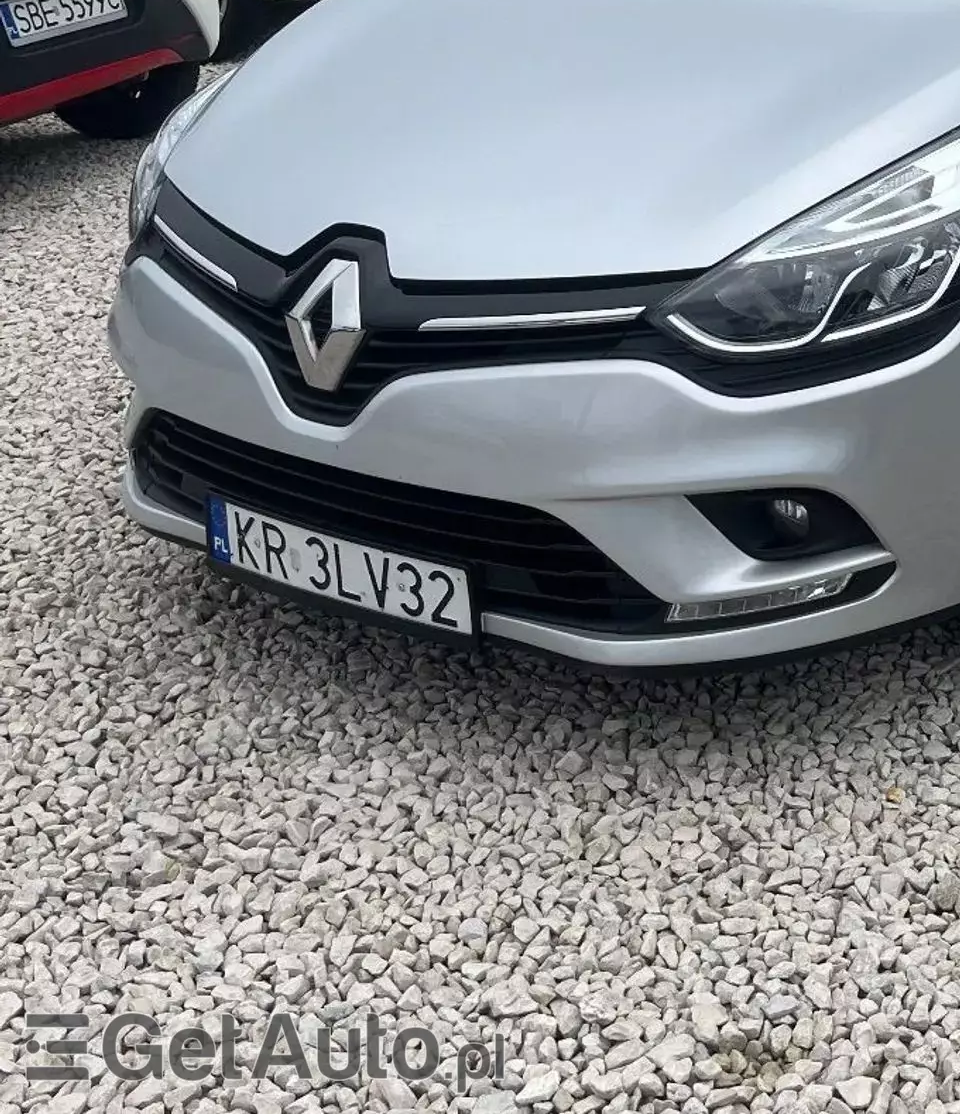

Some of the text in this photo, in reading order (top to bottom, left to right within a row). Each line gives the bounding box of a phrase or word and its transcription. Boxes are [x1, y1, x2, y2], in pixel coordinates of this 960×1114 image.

[213, 535, 229, 554] PL
[234, 510, 459, 628] KR 3LV32
